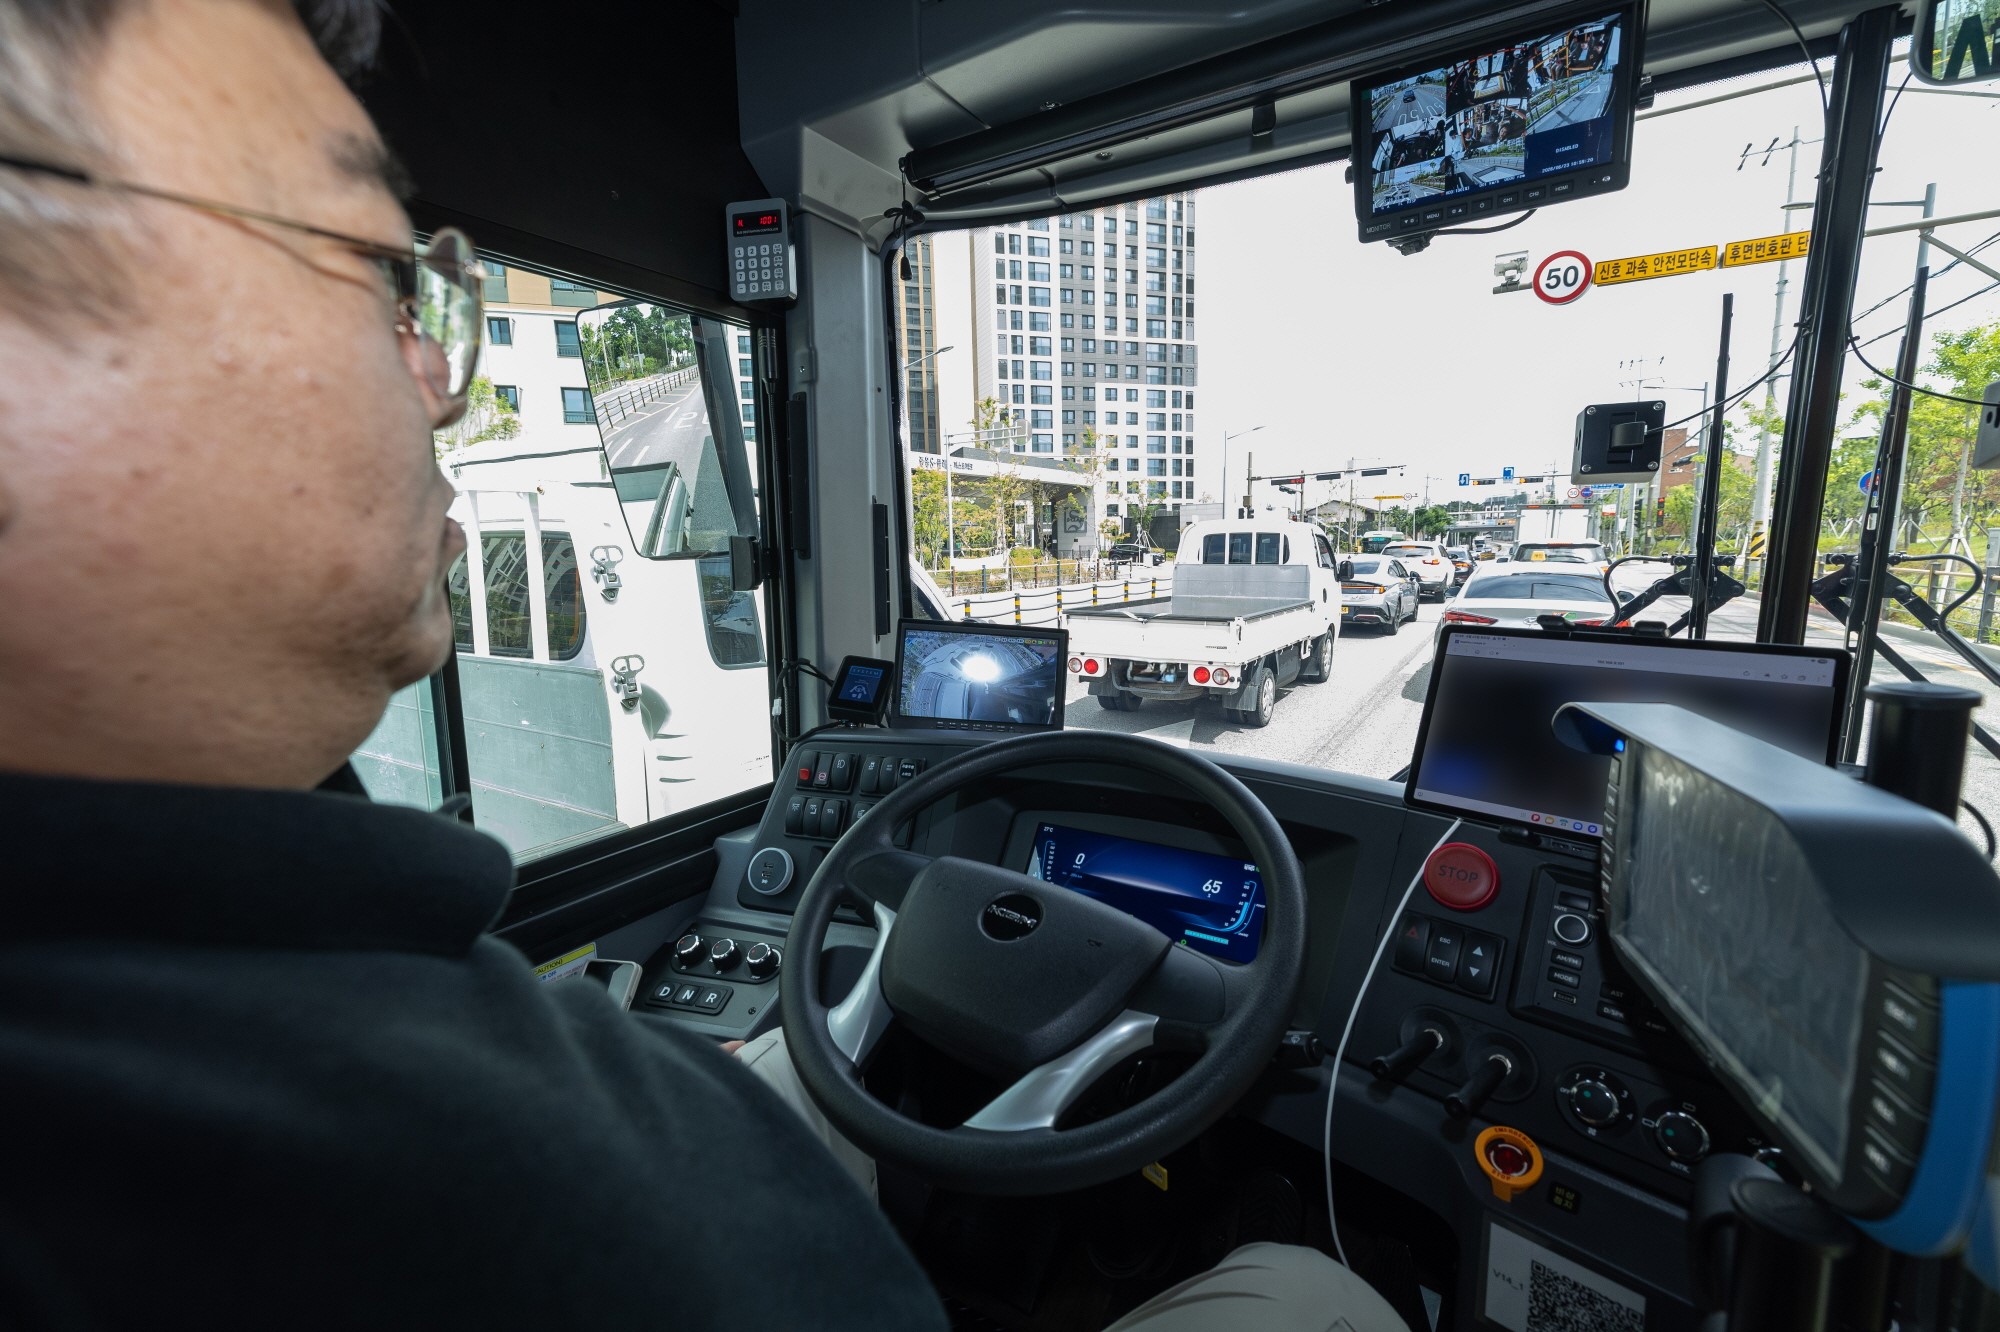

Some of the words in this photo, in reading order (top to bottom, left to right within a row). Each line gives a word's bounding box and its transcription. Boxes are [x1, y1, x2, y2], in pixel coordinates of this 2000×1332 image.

[1555, 143, 1579, 154] DISABLED
[1366, 222, 1392, 234] MONITOR
[1729, 237, 1792, 263] 후면번호판
[1599, 262, 1621, 280] 신호
[1625, 257, 1648, 276] 과속
[1653, 250, 1713, 274] 안전모단속
[1545, 265, 1579, 291] 50
[1075, 852, 1086, 865] 0
[1438, 865, 1479, 883] STOP
[1202, 879, 1223, 894] 65
[1553, 904, 1568, 912] MUTE
[1439, 936, 1451, 944] ESC
[1431, 957, 1450, 968] ENTER
[1555, 954, 1579, 965] AM/FM
[1553, 972, 1574, 983] MODE
[658, 985, 671, 997] D
[682, 988, 695, 1000] N
[705, 992, 718, 1004] R
[1610, 989, 1625, 998] AST
[1621, 1090, 1629, 1098] 3
[1491, 1168, 1511, 1180] STOP
[1493, 1267, 1524, 1291] V14_1
